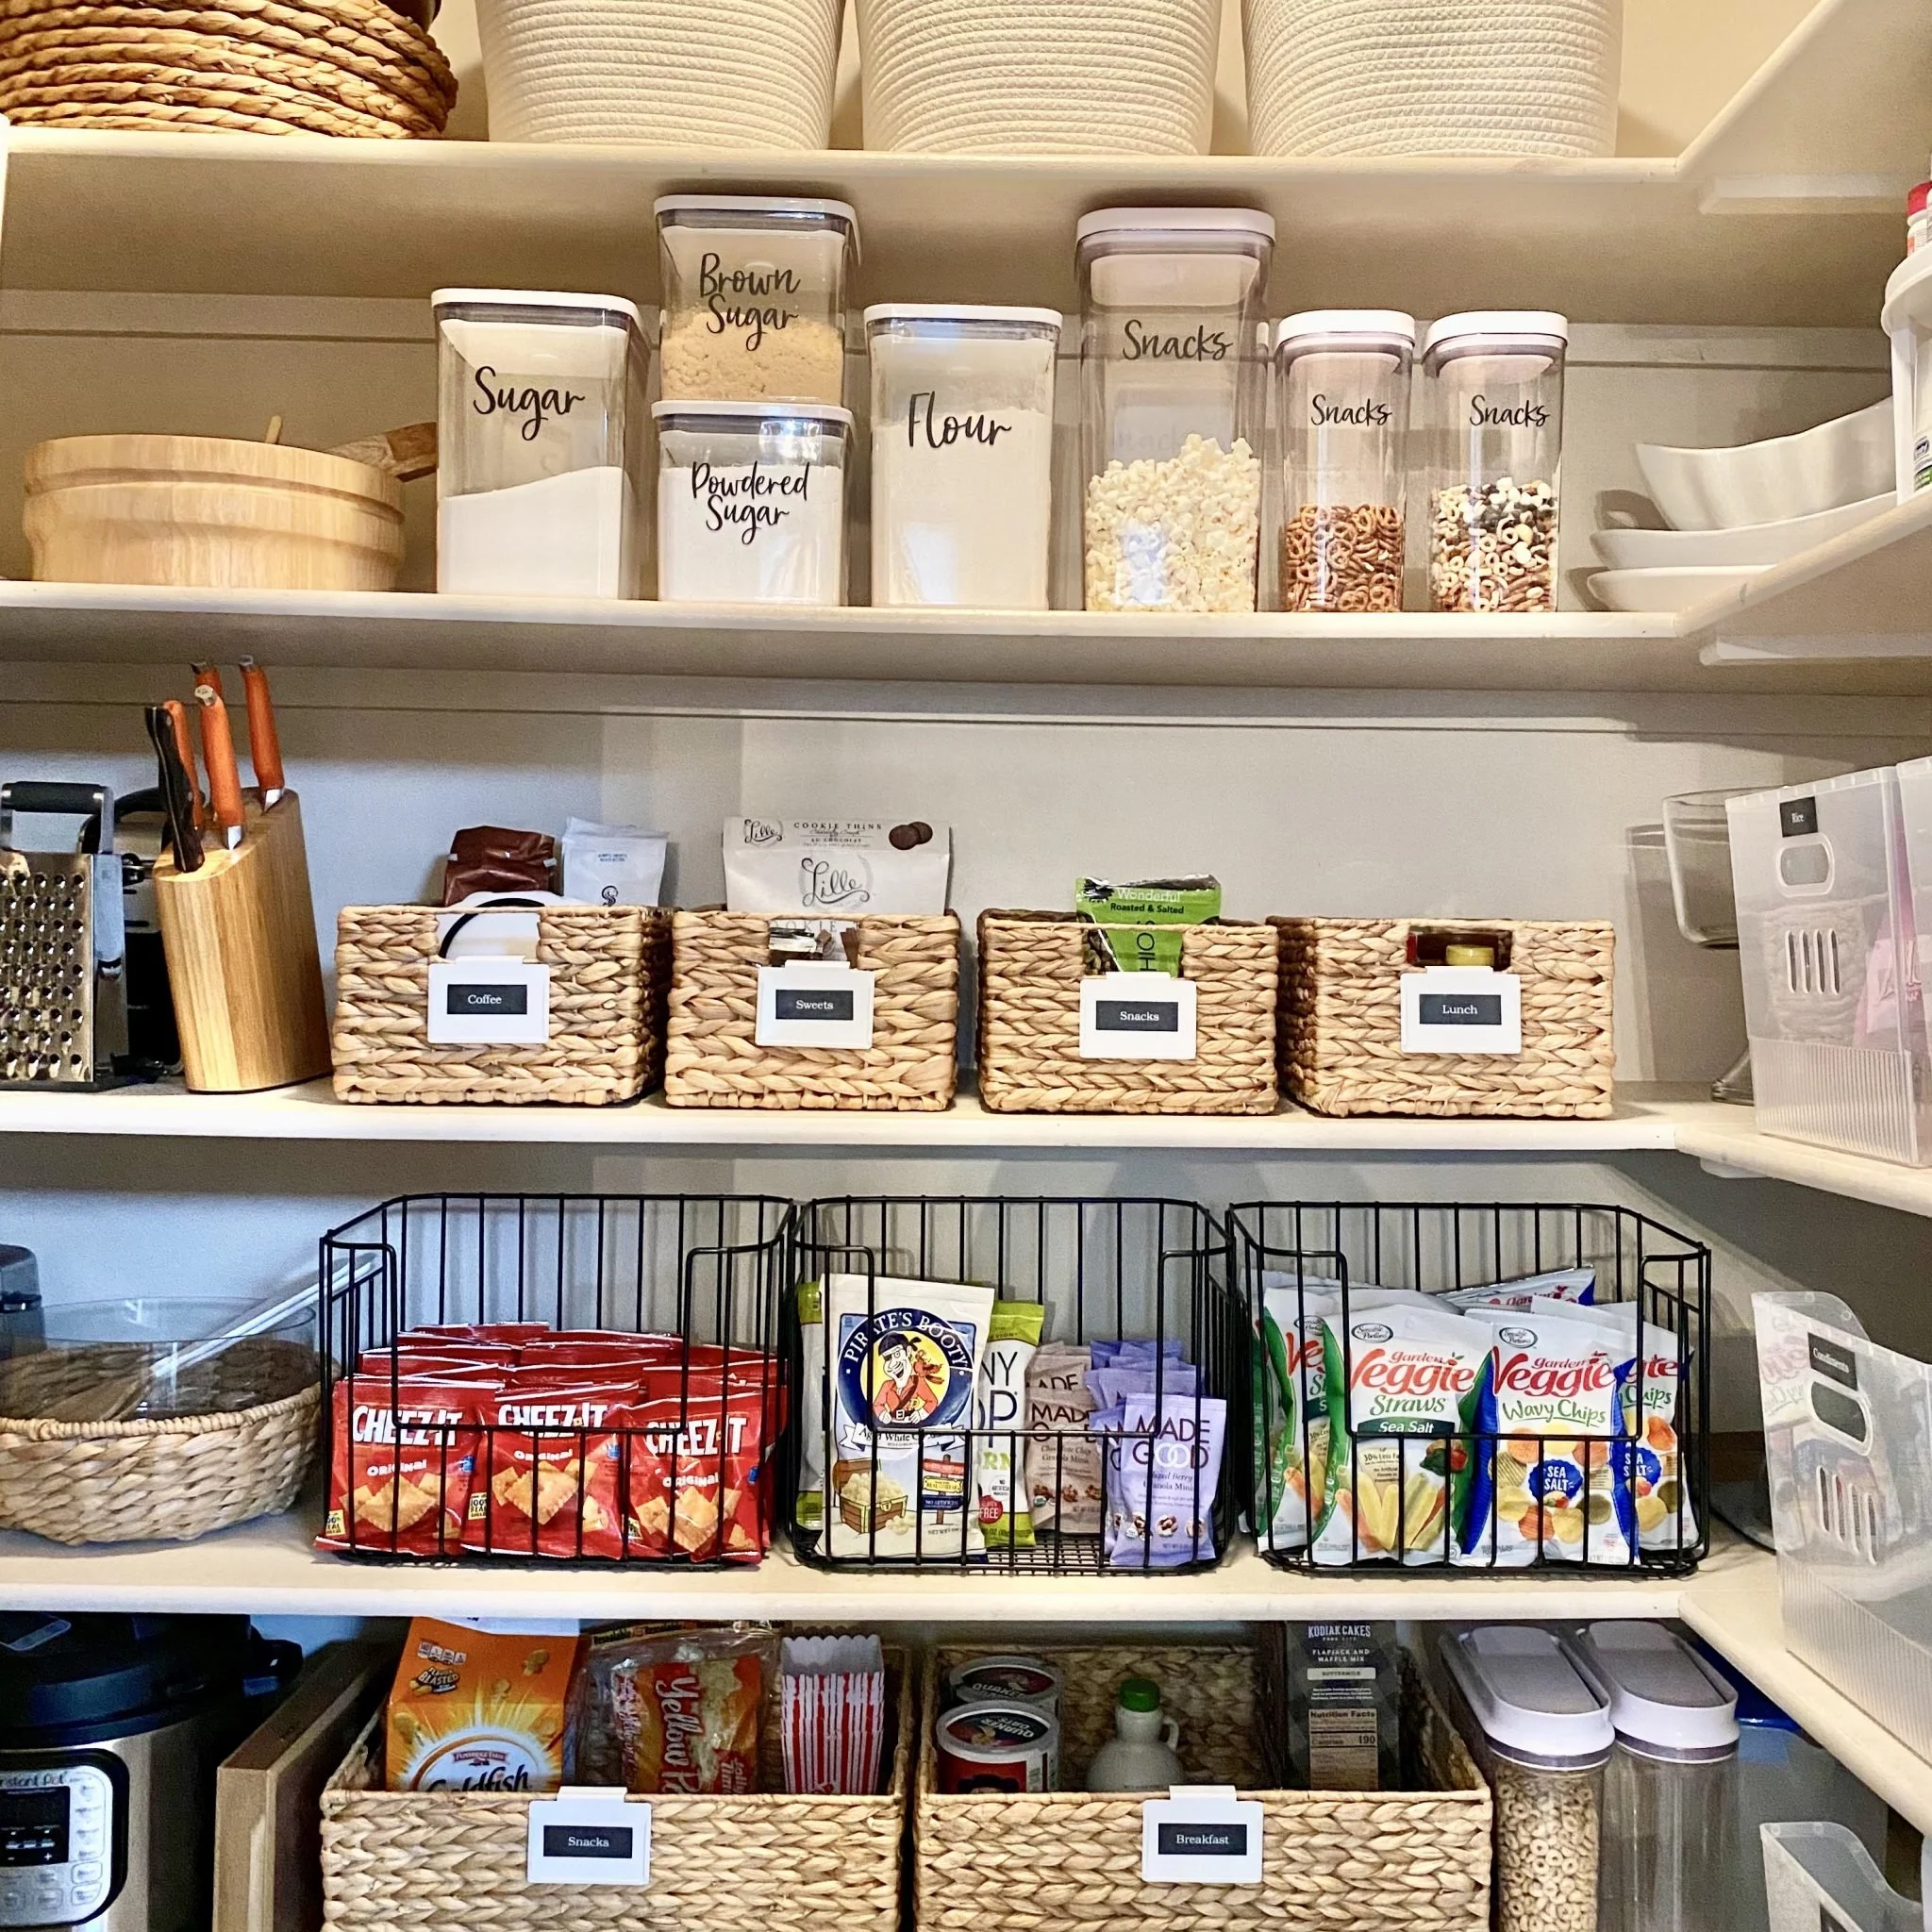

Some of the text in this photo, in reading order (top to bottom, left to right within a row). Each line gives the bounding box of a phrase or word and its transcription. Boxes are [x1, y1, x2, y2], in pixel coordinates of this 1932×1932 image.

[699, 252, 801, 297] Brown
[706, 295, 799, 352] Sugar
[1122, 320, 1234, 363] Snacks
[473, 366, 586, 441] Sugar
[1309, 393, 1393, 427] Snacks
[1468, 393, 1551, 428] Snacks
[907, 391, 1012, 450] Flour
[691, 461, 810, 501] Powdered
[706, 495, 791, 545] Sugar
[743, 818, 783, 843] Lille
[793, 822, 839, 830] COOKIE
[801, 857, 871, 908] Lille
[1117, 888, 1181, 903] Wonderful
[1110, 903, 1145, 912] Roasted
[1157, 905, 1185, 914] Salted
[467, 993, 503, 1006] Coffee
[795, 1000, 834, 1011] Sweets
[1441, 1003, 1478, 1015] Lunch
[1119, 1010, 1160, 1023] Snacks
[918, 1315, 969, 1369] BOOTY
[1349, 1347, 1475, 1396] Veggie
[1491, 1345, 1617, 1398] Veggie
[1370, 1394, 1447, 1416] Straws
[1502, 1398, 1607, 1427] Wavy Chips
[1135, 1414, 1210, 1443] MADE
[1379, 1422, 1435, 1434] Sea Salt
[1133, 1441, 1209, 1470] GOOD
[1624, 1453, 1644, 1465] SA
[1547, 1465, 1567, 1479] SEA
[1624, 1464, 1647, 1476] SLT
[1543, 1478, 1570, 1491] SALT
[1307, 1624, 1372, 1639] KODIAK CAKES
[655, 1676, 705, 1767] Yellow
[1358, 1734, 1376, 1744] 190
[568, 1836, 610, 1848] Snacks
[1175, 1833, 1230, 1845] Breakfast
